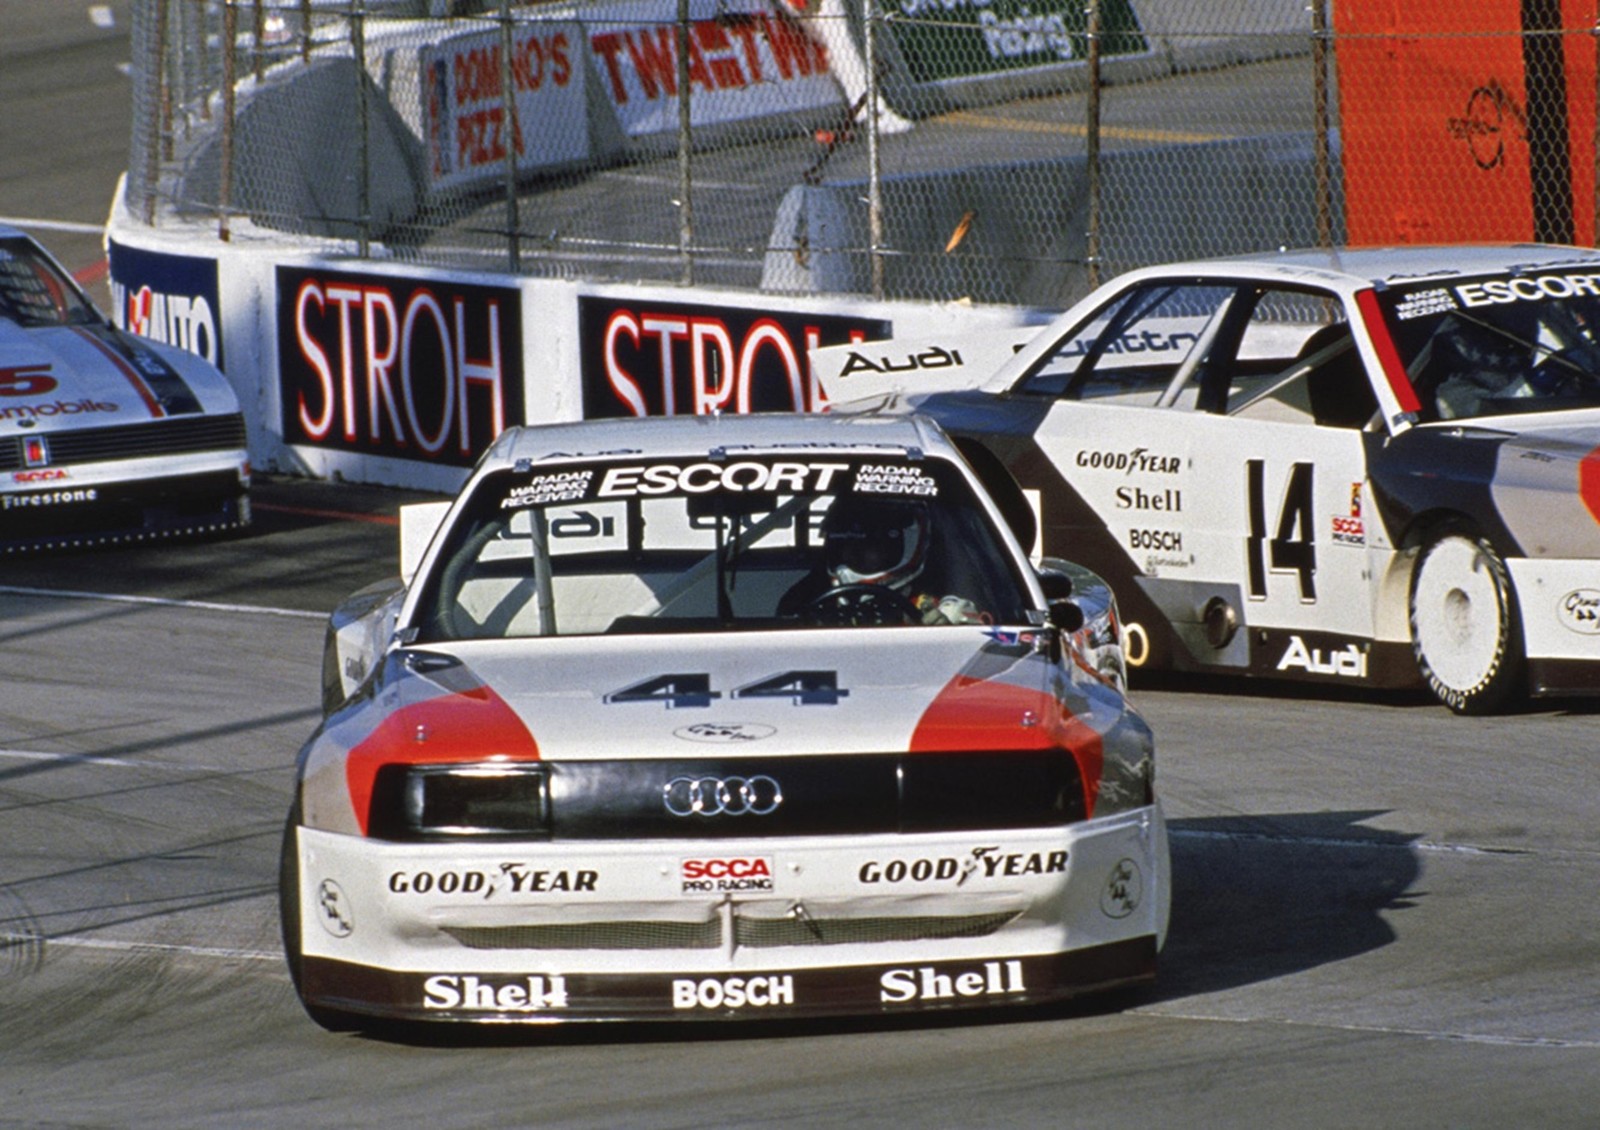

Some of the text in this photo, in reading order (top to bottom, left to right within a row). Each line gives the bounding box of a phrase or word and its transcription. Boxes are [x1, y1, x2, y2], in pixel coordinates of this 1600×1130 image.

[295, 278, 504, 457] STROH
[839, 346, 963, 378] Audi
[0, 399, 119, 419] mobile
[532, 471, 593, 486] RADAR
[597, 462, 849, 497] ESCORT
[856, 473, 935, 486] WARNING
[860, 464, 921, 476] RADAR
[1, 489, 97, 510] Firestone
[501, 490, 585, 508] RECEIVER
[510, 481, 588, 498] WARNING
[853, 482, 938, 496] RECEIVER
[1116, 486, 1181, 512] Shell
[1130, 529, 1182, 551] BOSCH
[1244, 459, 1316, 604] 14
[1276, 635, 1367, 677] Audi
[602, 670, 850, 709] 44
[682, 858, 770, 878] SCCA
[682, 878, 774, 892] PRO RACING
[423, 975, 569, 1009] Shell
[673, 975, 794, 1009] BOSCH
[880, 961, 1027, 1002] Shell
